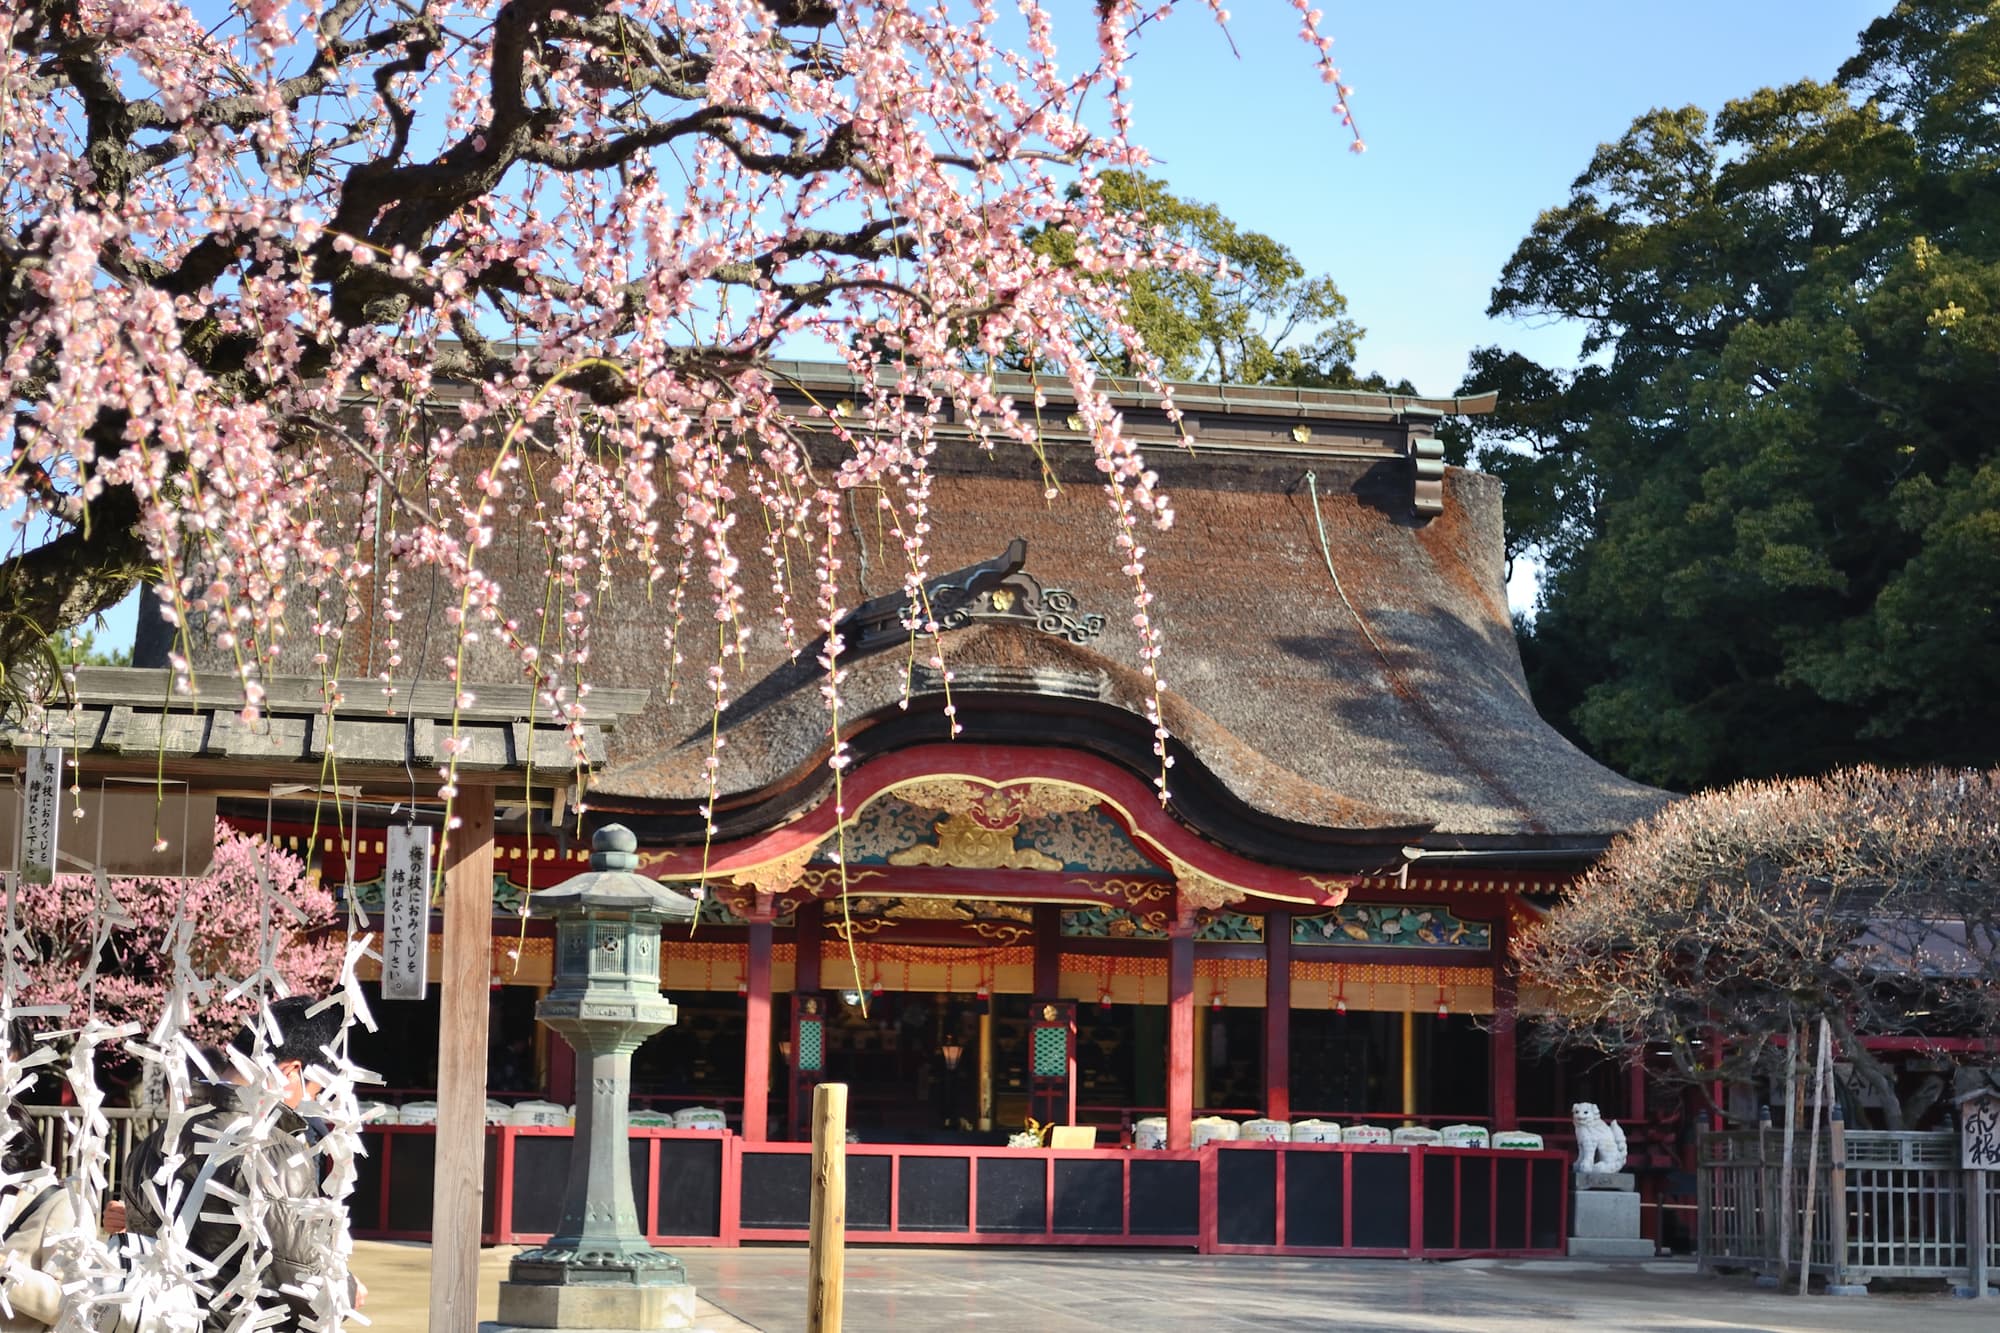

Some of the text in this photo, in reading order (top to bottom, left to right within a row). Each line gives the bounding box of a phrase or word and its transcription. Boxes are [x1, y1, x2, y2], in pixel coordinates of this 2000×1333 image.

[389, 869, 406, 989] 結ばないで下さい。
[407, 846, 424, 973] 梅の枝におみくじを
